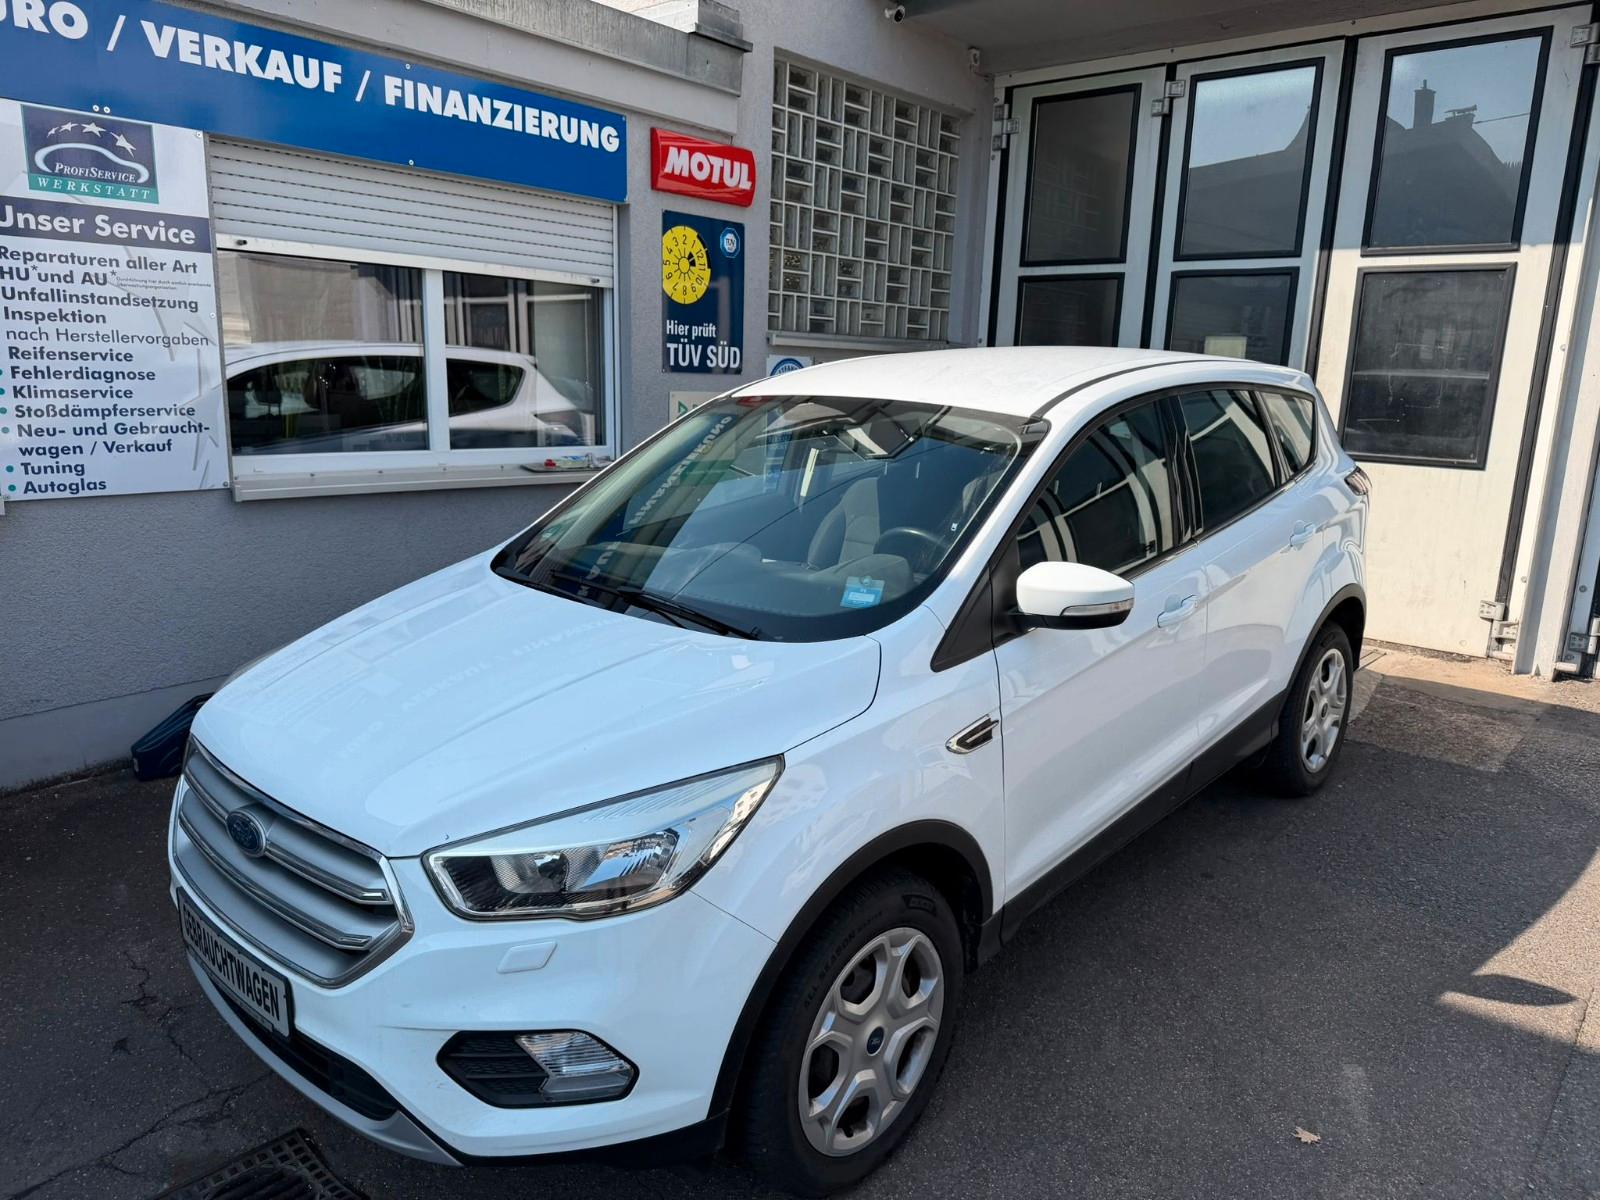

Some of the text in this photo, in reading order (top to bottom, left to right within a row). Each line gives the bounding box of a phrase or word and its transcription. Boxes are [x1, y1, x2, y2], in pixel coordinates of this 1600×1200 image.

[0, 0, 88, 39] RO
[140, 20, 342, 94] VERKAUF
[384, 75, 620, 153] FINANZIERUNG
[663, 146, 752, 191] MOTUL
[38, 176, 151, 199] WERKSTATT
[0, 204, 196, 245] Unser Service
[0, 245, 198, 274] Reparaturen aller Art
[38, 271, 74, 284] und
[1, 286, 199, 313] Unfallinstandsetzung
[3, 306, 107, 324] Inspektion
[6, 327, 209, 348] nach Herstellervorgaben
[666, 319, 716, 340] Hier prüft
[8, 346, 134, 362] Reifenservice
[666, 338, 741, 369] TÜV SÜD
[10, 365, 156, 383] Fehlerdiagnose
[12, 385, 134, 399] Klimaservice
[15, 403, 196, 420] Stoßdämpferservice
[17, 421, 210, 438] Neu- und Gebraucht-
[18, 445, 84, 459] wagen
[103, 439, 173, 454] Verkauf
[20, 461, 85, 476] Tuning
[23, 478, 107, 494] Autoglas
[183, 906, 280, 1021] GEBRAUCHTWAGEN
